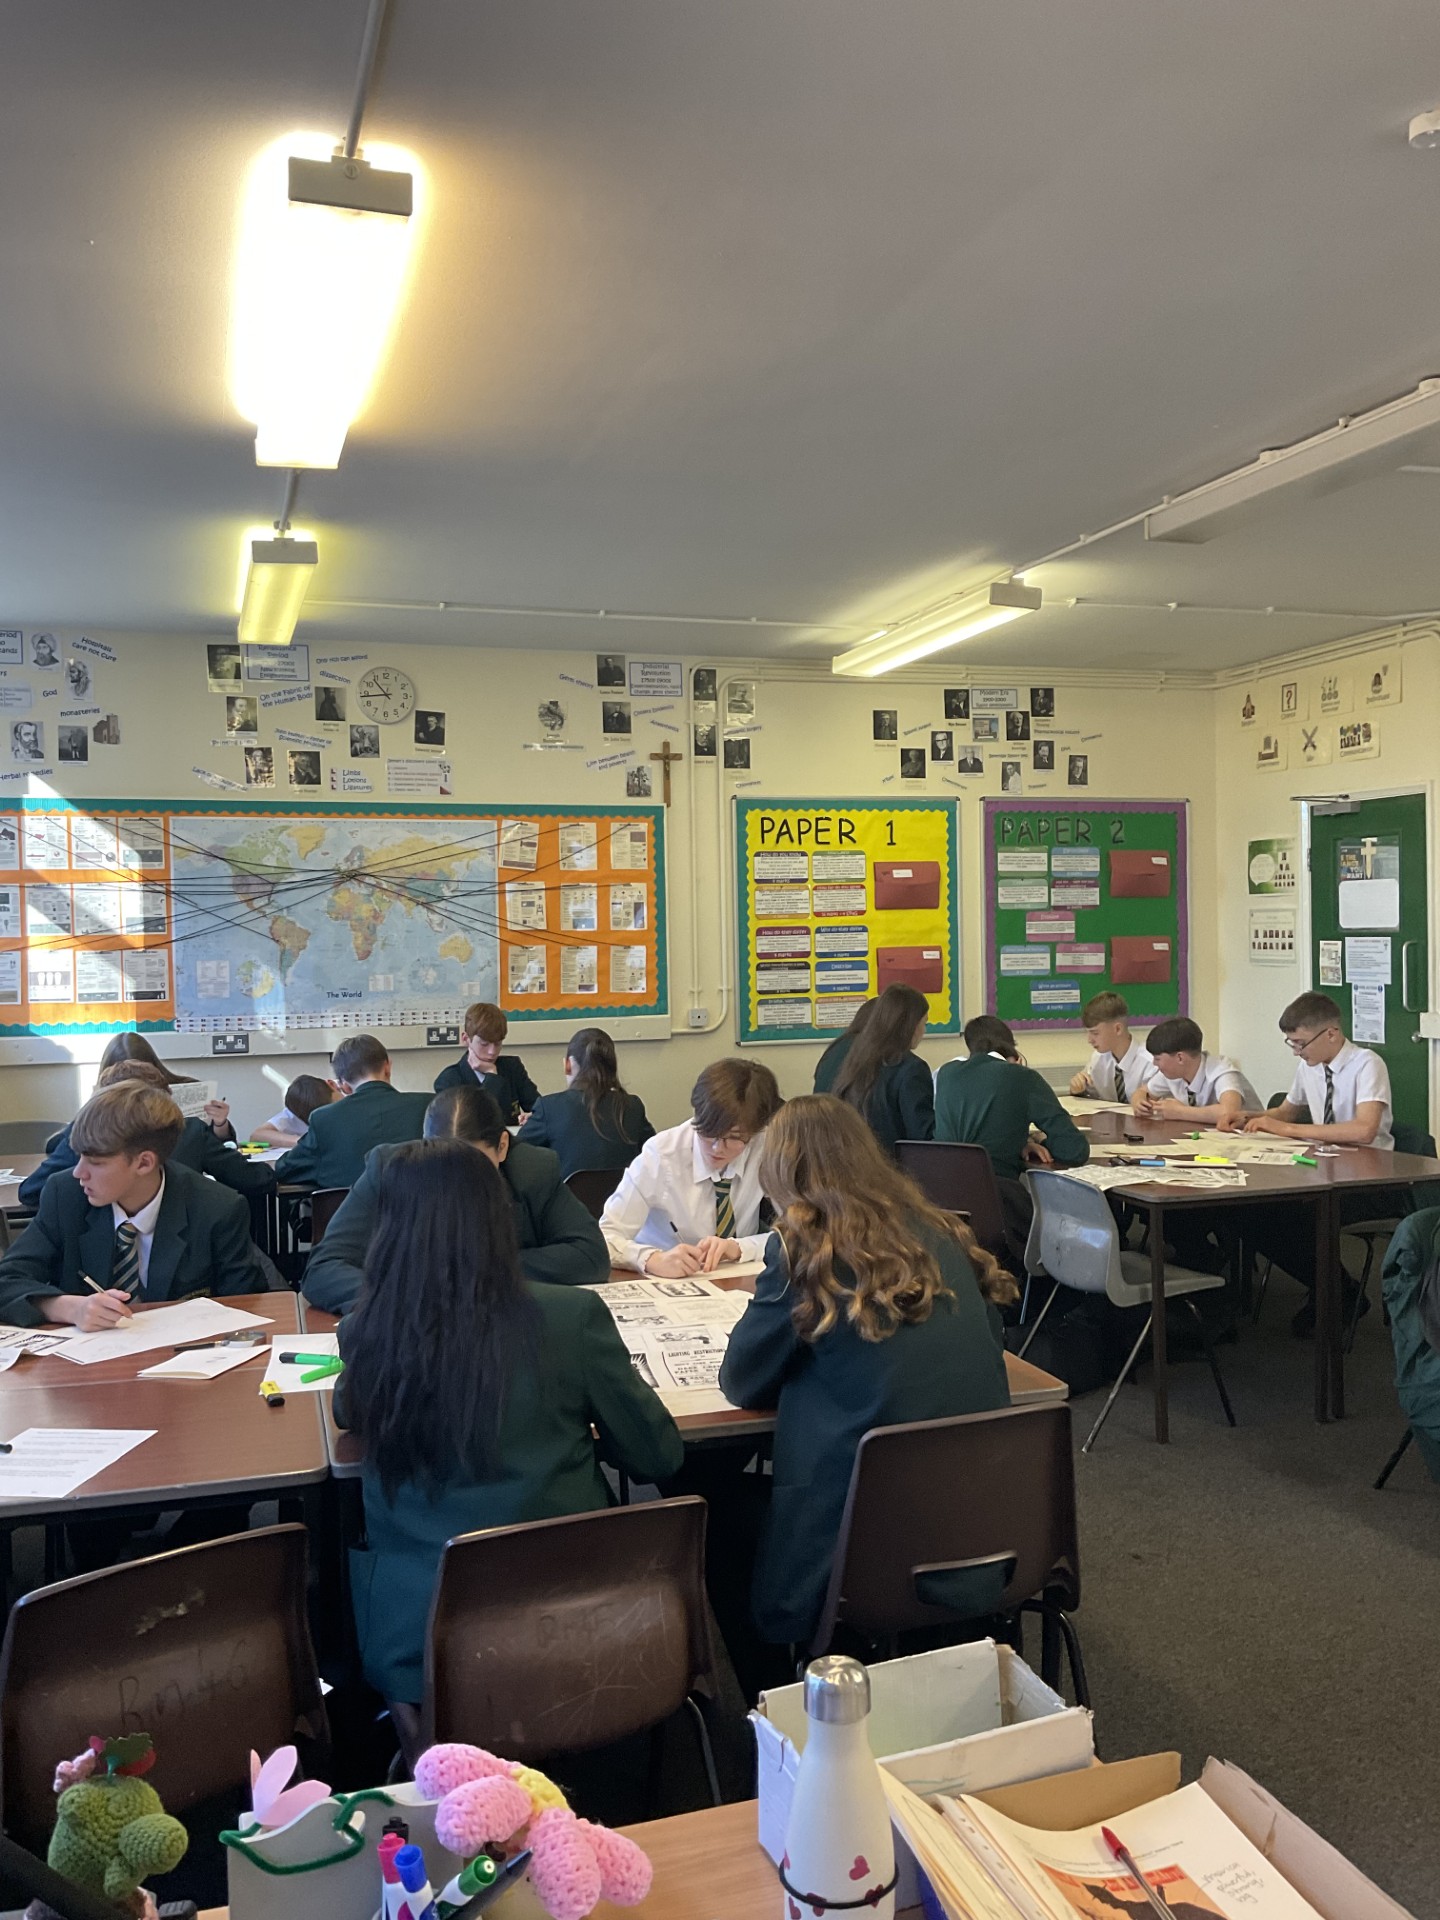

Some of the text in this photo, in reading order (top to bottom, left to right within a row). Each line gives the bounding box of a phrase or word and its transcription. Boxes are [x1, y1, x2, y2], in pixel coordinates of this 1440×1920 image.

[81, 636, 112, 653] Hospitals
[72, 641, 118, 662] care not Cure
[320, 670, 352, 684] dissection
[383, 672, 390, 680] 12
[42, 689, 58, 698] God
[260, 694, 270, 702] On
[60, 707, 100, 718] monasteries
[760, 816, 897, 846] PAPER 1
[1001, 818, 1126, 845] PAPER 2
[341, 990, 362, 998] World
